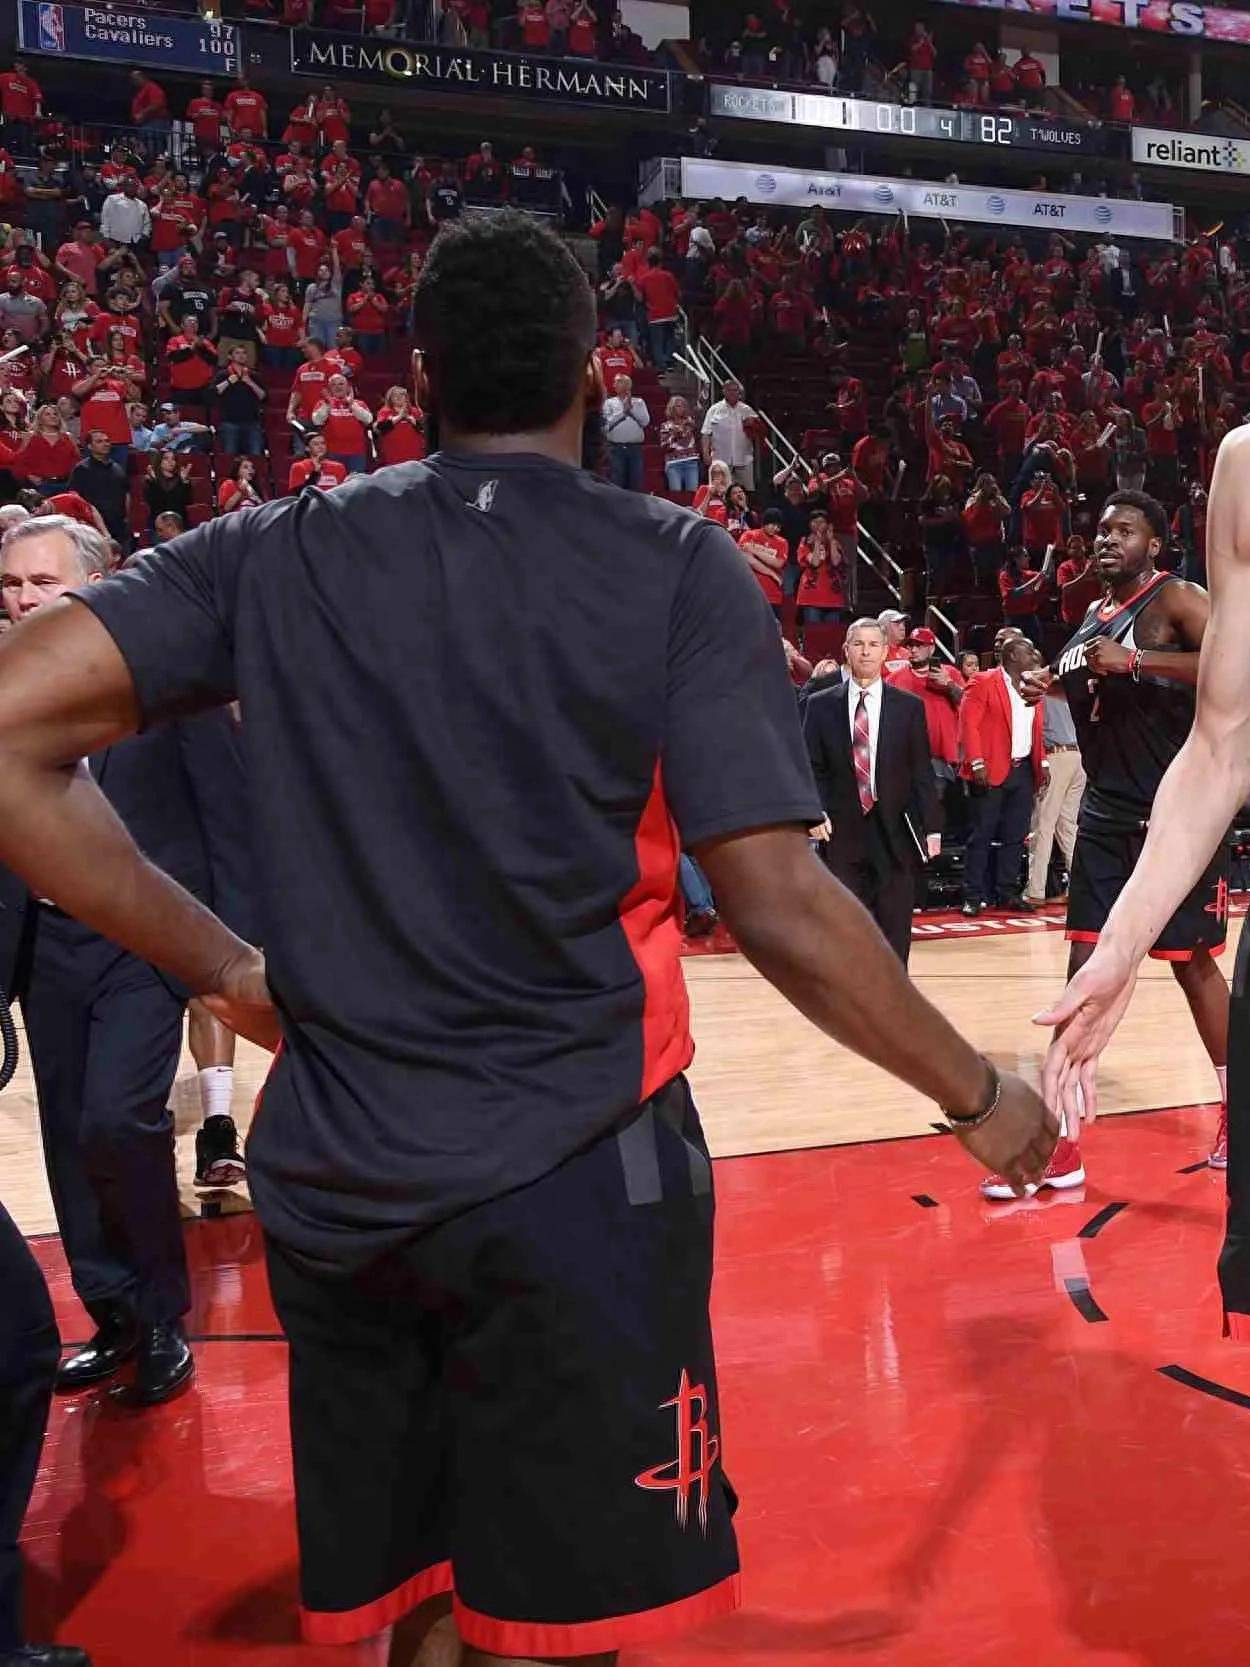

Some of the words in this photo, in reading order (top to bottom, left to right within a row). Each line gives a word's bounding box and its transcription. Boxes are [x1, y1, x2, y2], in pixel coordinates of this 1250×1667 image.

[84, 7, 147, 29] Pacers
[210, 23, 233, 40] 97
[85, 24, 174, 49] Cavaliers
[199, 38, 235, 56] 100
[226, 57, 238, 72] F
[309, 41, 480, 82] MEMORIAL
[492, 62, 649, 99] HERMANN
[941, 119, 952, 137] 4
[981, 116, 1012, 145] 82
[1146, 139, 1222, 167] reliant
[922, 192, 959, 209] AT&T
[1033, 203, 1067, 219] AT&T
